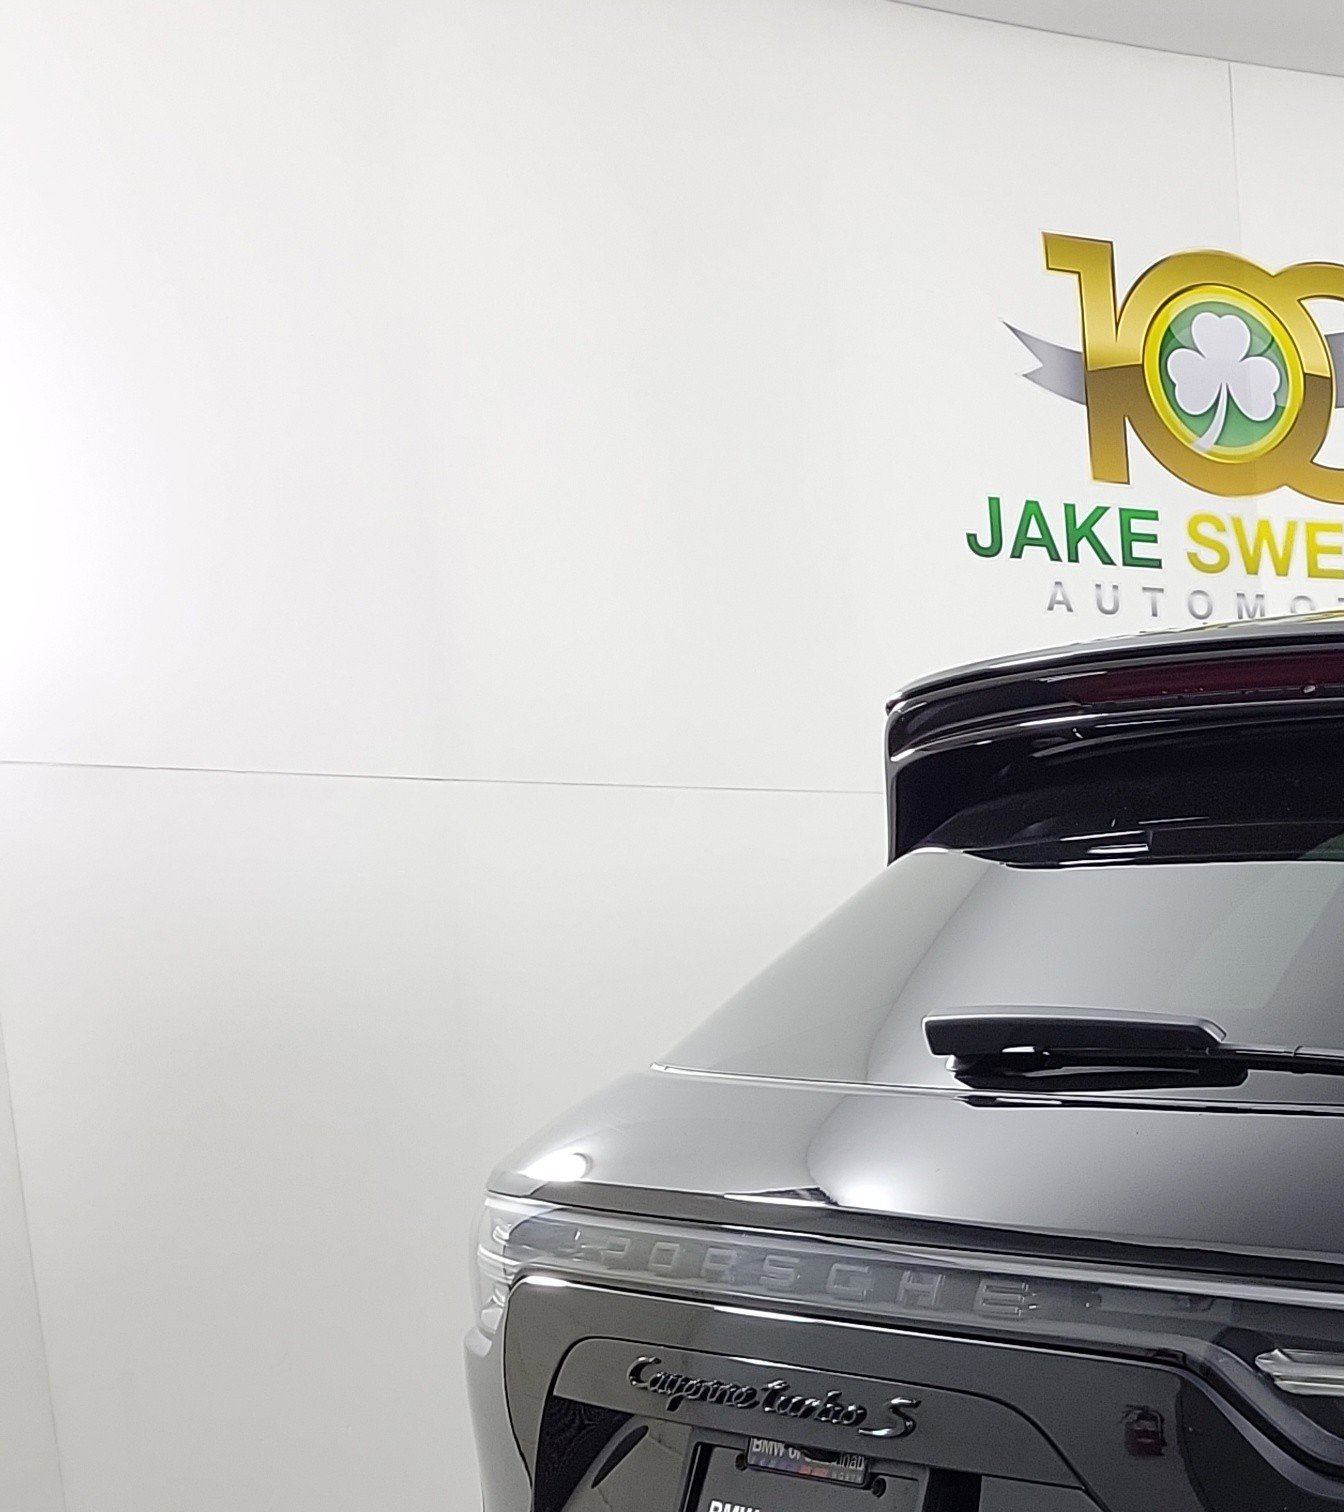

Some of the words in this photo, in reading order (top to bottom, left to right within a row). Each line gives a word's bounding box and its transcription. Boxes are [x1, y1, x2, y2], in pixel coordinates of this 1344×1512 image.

[966, 496, 1163, 569] JAKE
[601, 1236, 1030, 1317] PORSCHE
[627, 1357, 757, 1411] Cayenne
[858, 1397, 921, 1438] S
